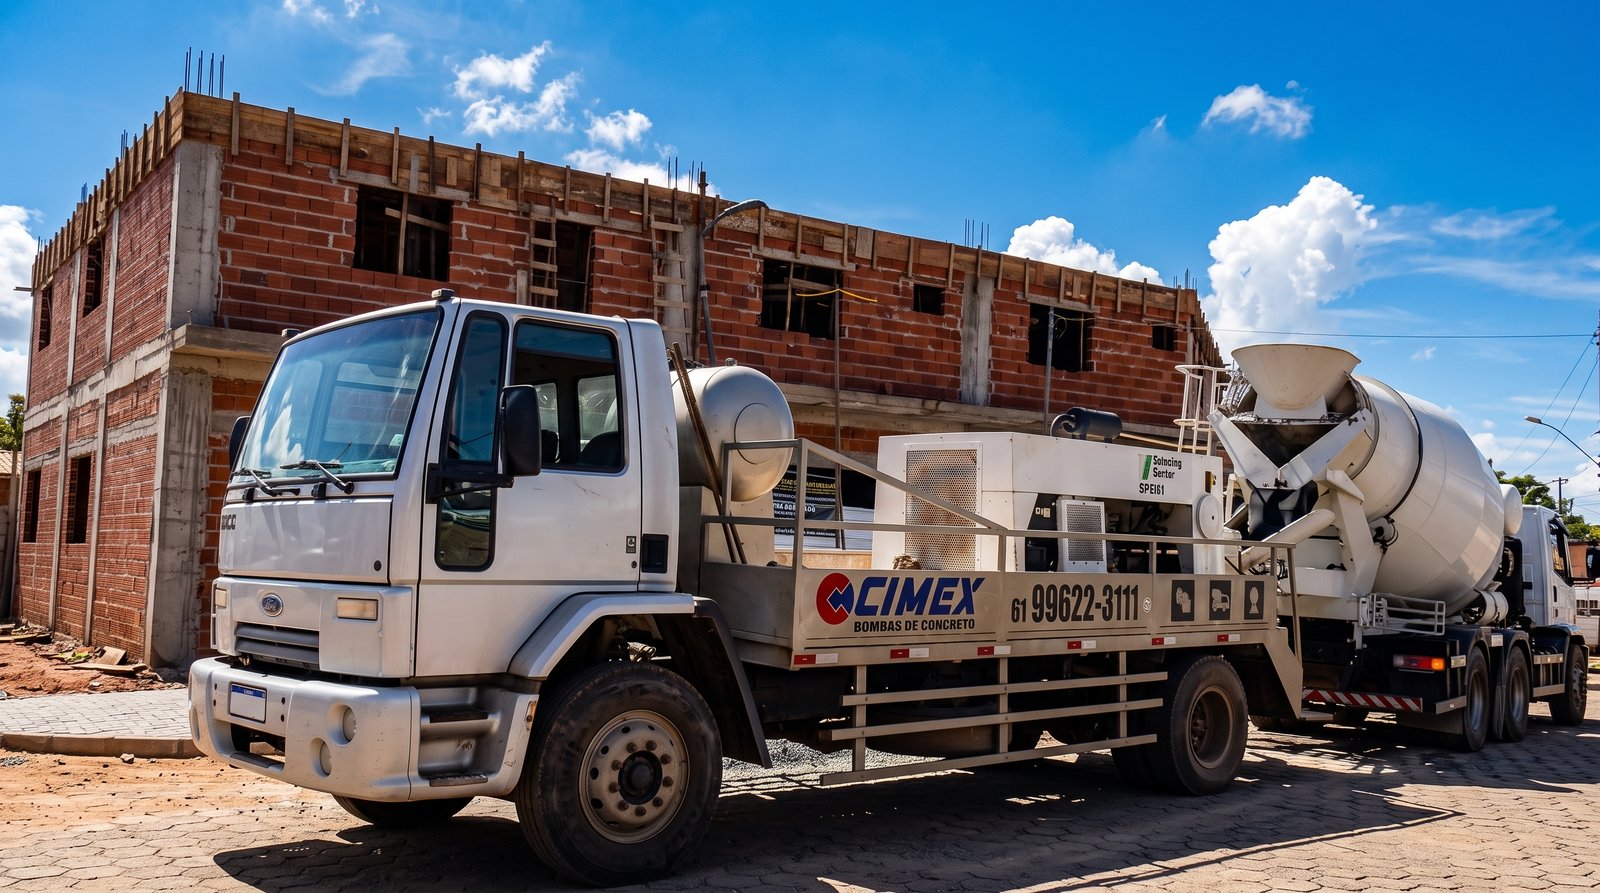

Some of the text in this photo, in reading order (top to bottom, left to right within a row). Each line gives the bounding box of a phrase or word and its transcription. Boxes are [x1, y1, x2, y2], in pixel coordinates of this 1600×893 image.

[854, 576, 985, 616] CIMEX
[1011, 584, 1139, 623] 61 99622-3111
[854, 618, 975, 632] BOMBAS DE CONCRETO
